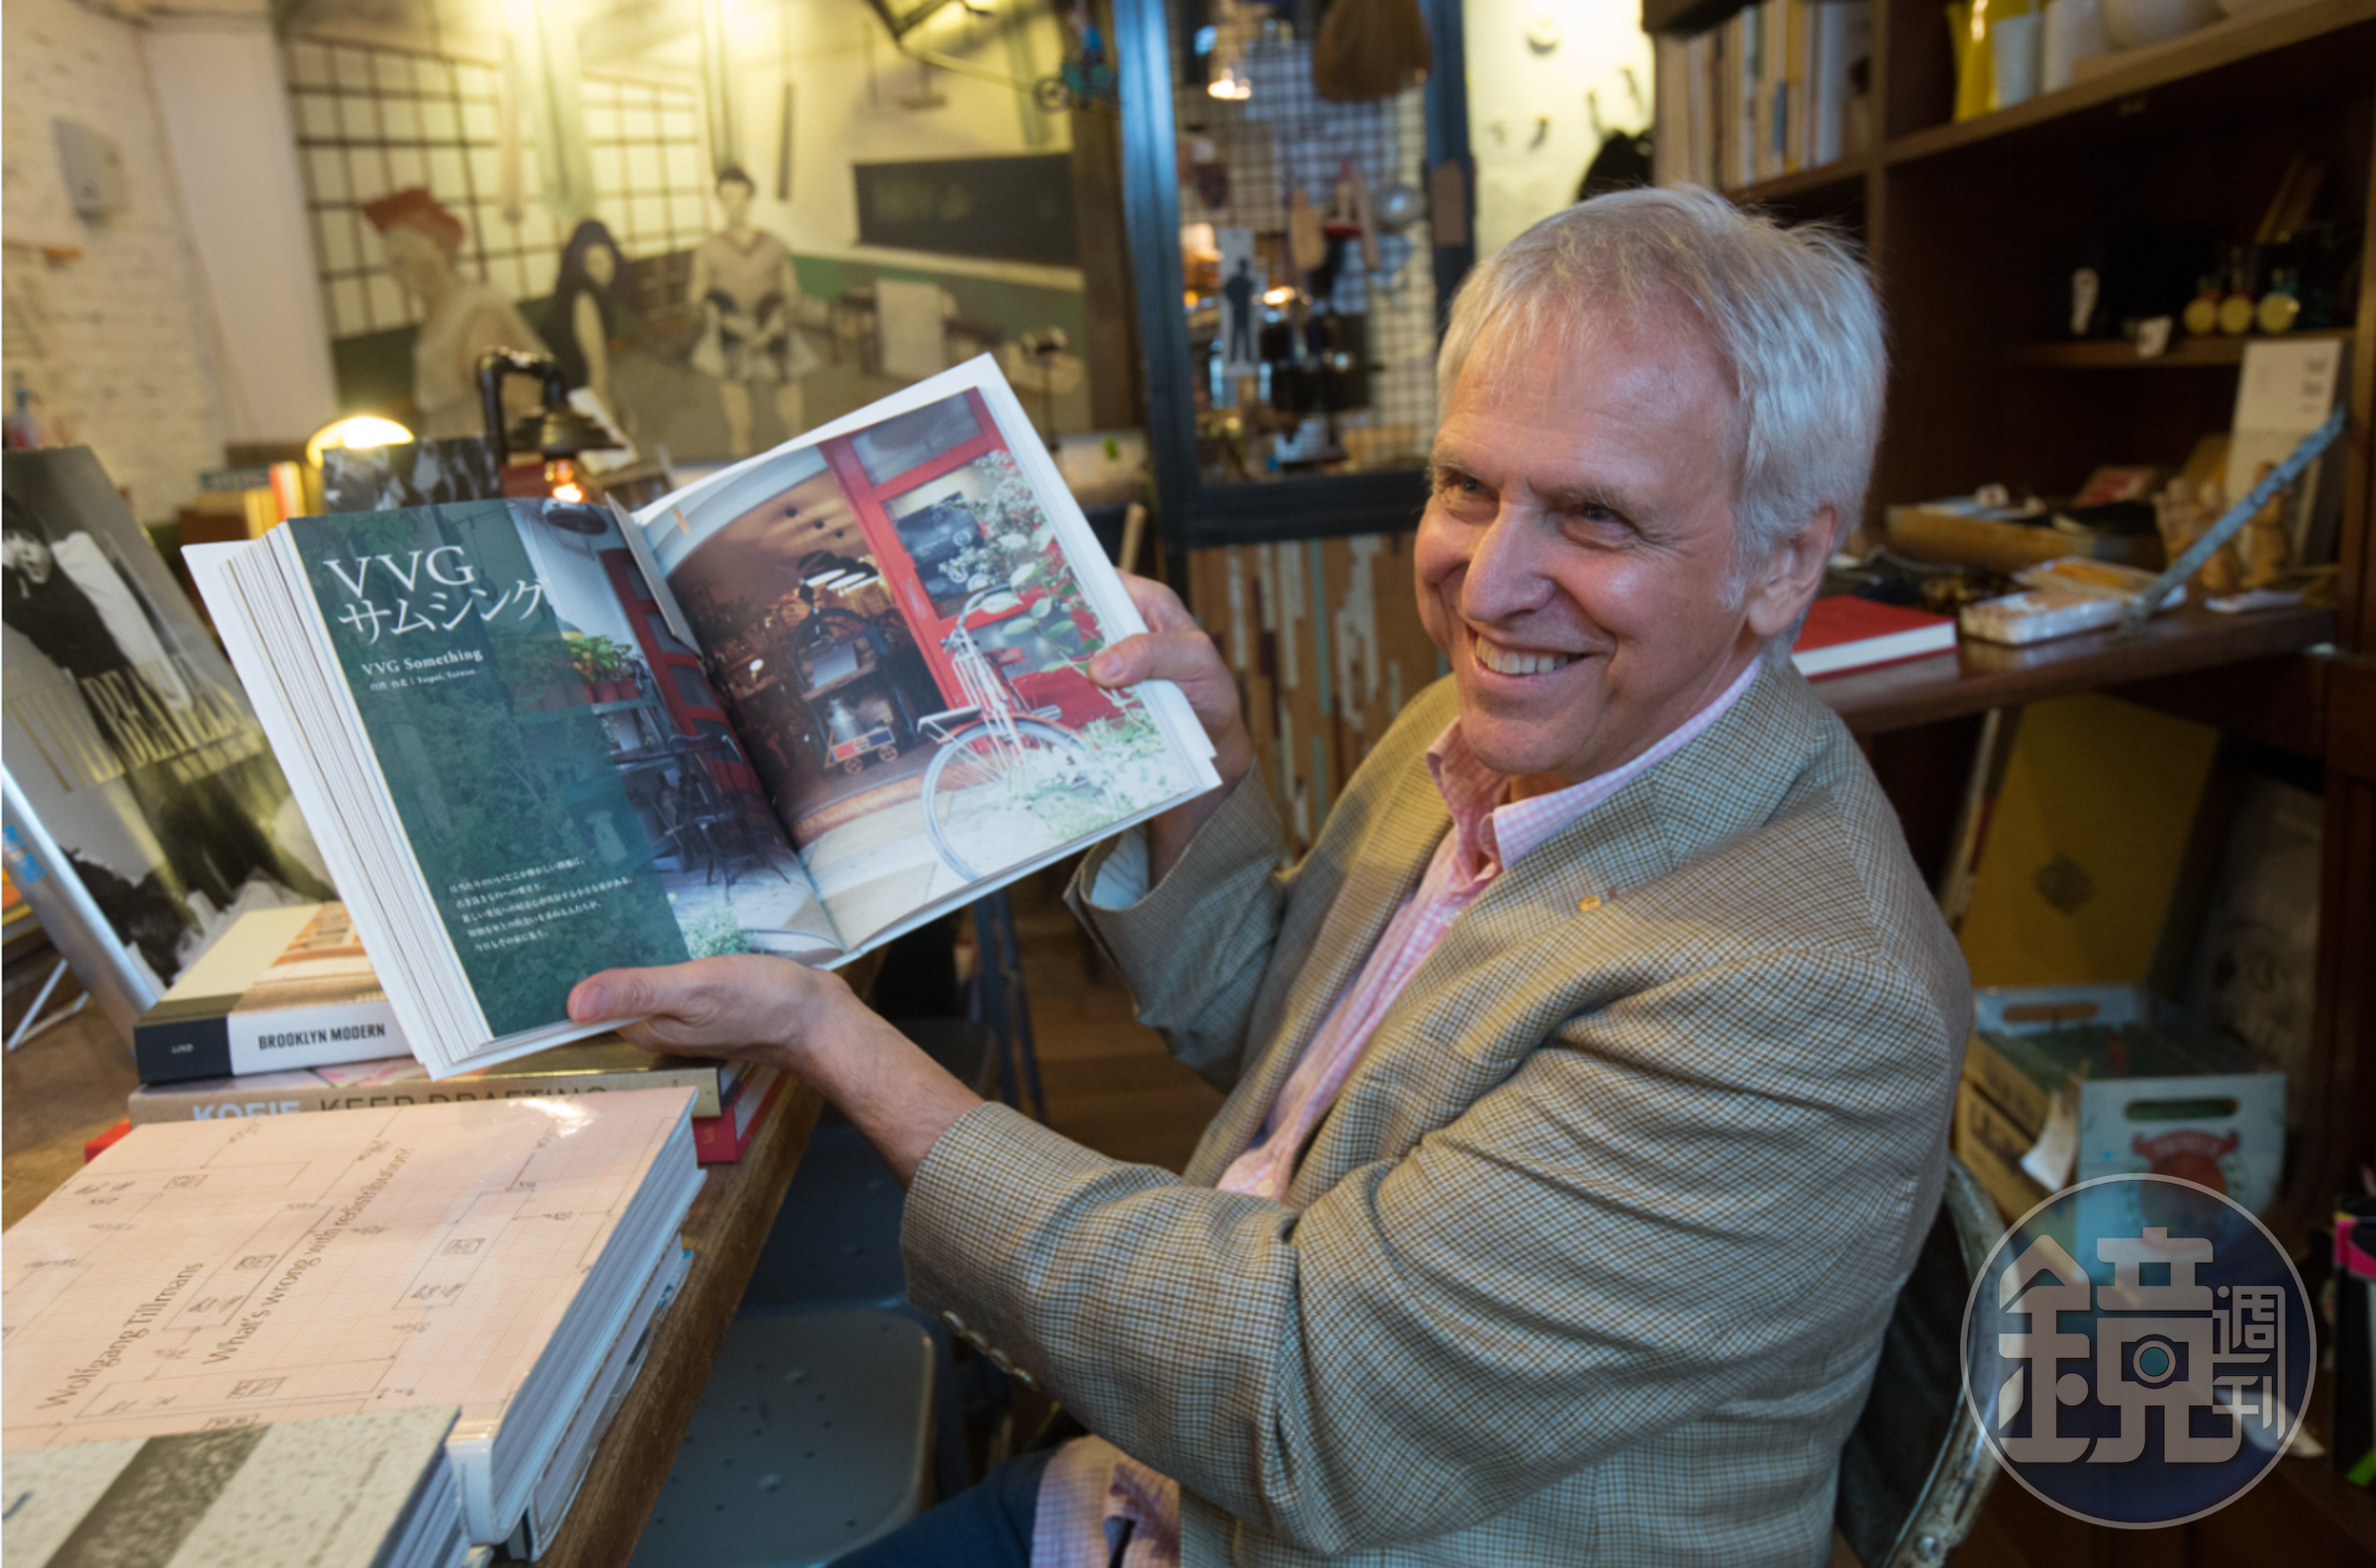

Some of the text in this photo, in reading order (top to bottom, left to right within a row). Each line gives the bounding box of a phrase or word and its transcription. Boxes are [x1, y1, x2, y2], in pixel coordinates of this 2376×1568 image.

[323, 545, 476, 599] VVG
[338, 577, 548, 643] サムシング
[361, 649, 484, 675] VVG Something
[258, 1023, 386, 1050] BROOKLYN MODERN
[201, 1307, 271, 1365] What's
[260, 1257, 323, 1309] wrong
[303, 1226, 345, 1256] with
[36, 1327, 150, 1410] Wolfgang
[123, 1263, 204, 1328] Tillmans
